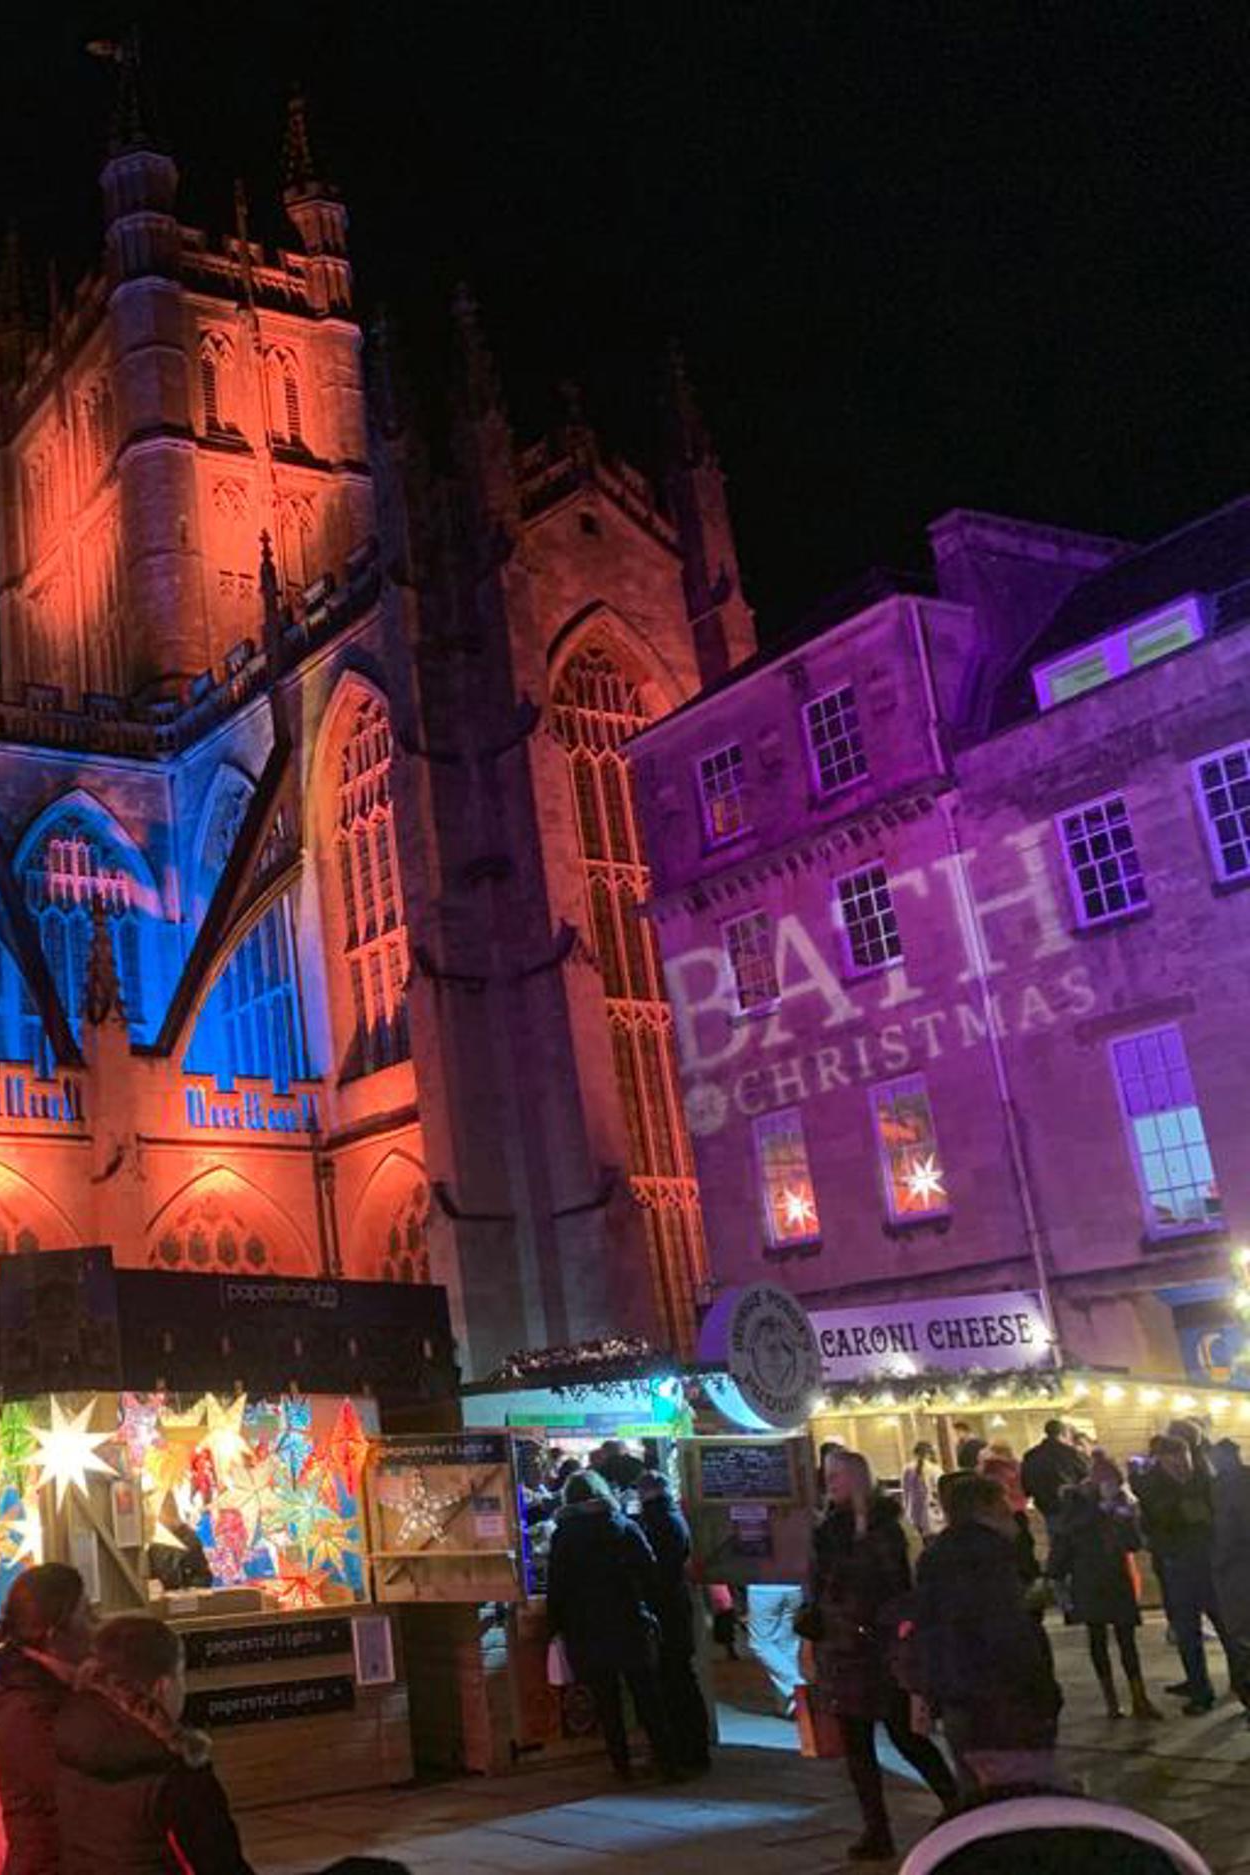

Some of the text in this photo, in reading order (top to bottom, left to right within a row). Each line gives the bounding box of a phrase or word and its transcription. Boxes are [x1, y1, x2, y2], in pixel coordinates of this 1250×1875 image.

[663, 820, 1075, 1074] BATH
[734, 967, 1096, 1115] CHRISTMAS
[820, 1313, 1033, 1358] CARONI CHEESE
